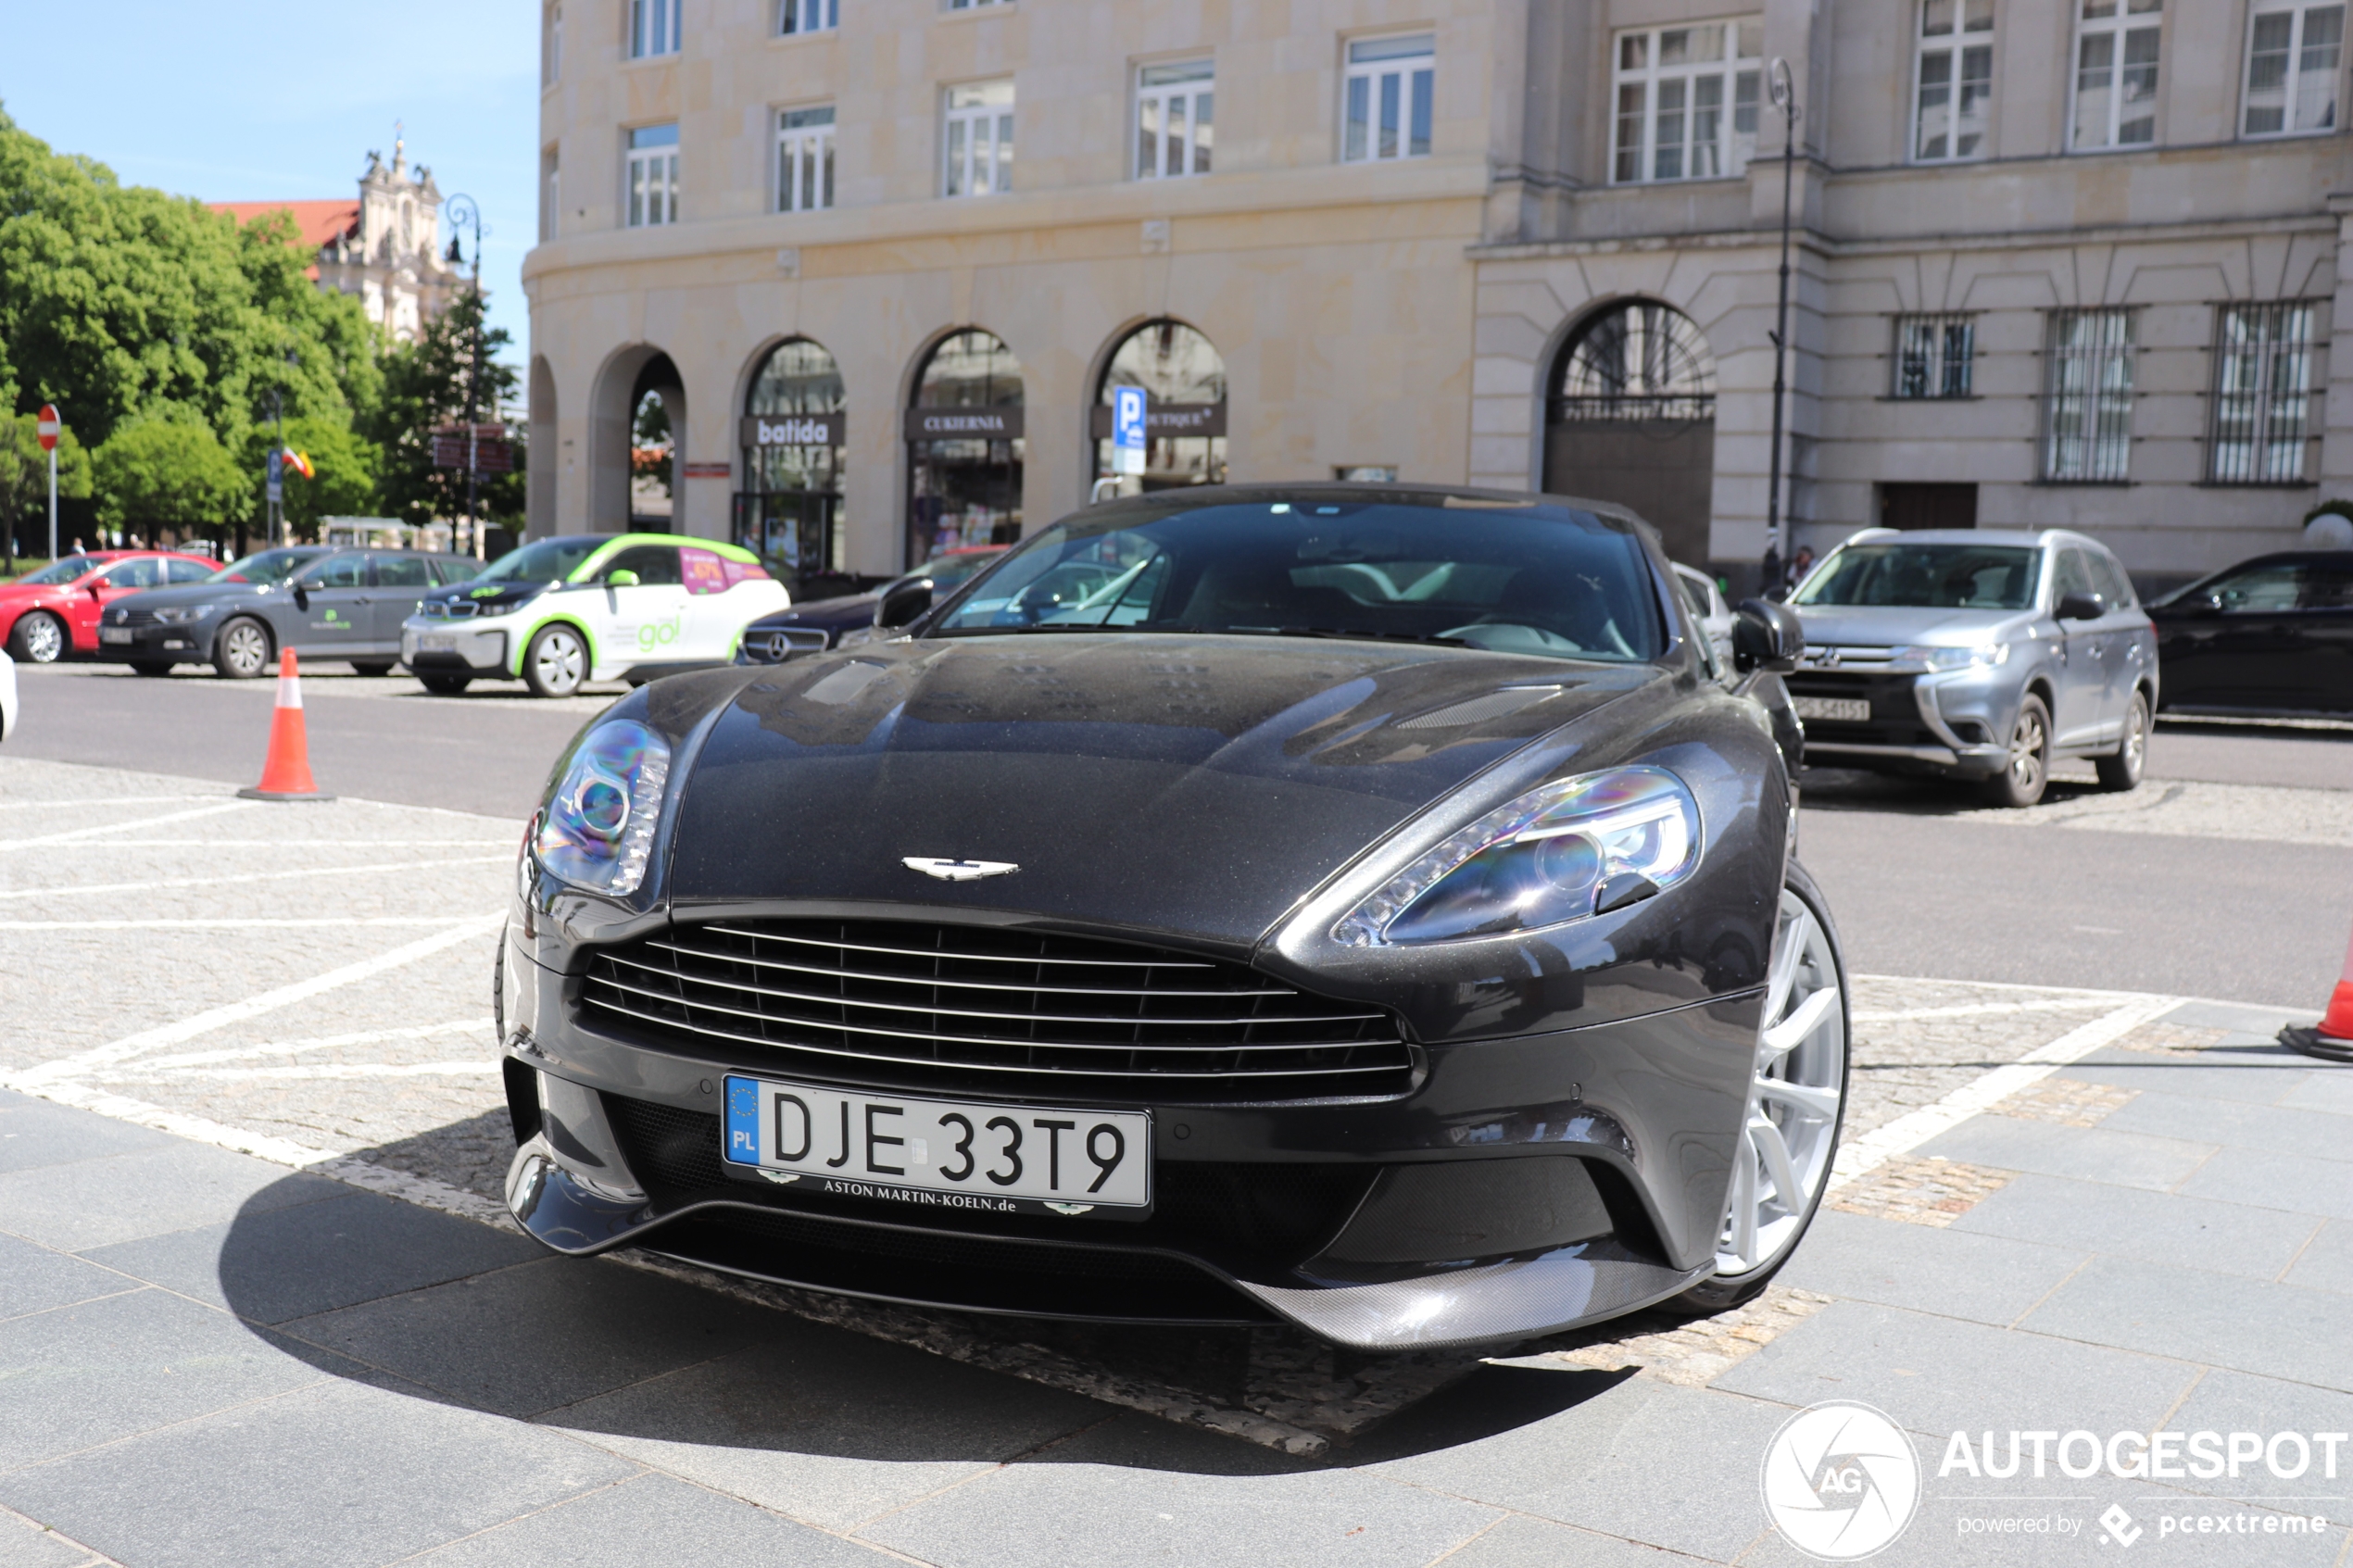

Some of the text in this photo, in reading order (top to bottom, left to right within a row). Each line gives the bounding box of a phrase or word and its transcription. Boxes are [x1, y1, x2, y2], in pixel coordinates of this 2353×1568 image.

[924, 415, 1004, 432] CUKIERNIA
[1119, 391, 1141, 432] P
[758, 419, 829, 445] batida
[637, 614, 680, 652] go!
[733, 1130, 756, 1151] PL
[774, 1092, 1126, 1194] DJE 33T9
[824, 1180, 1017, 1213] ASTON MARTIN-KOELN.de
